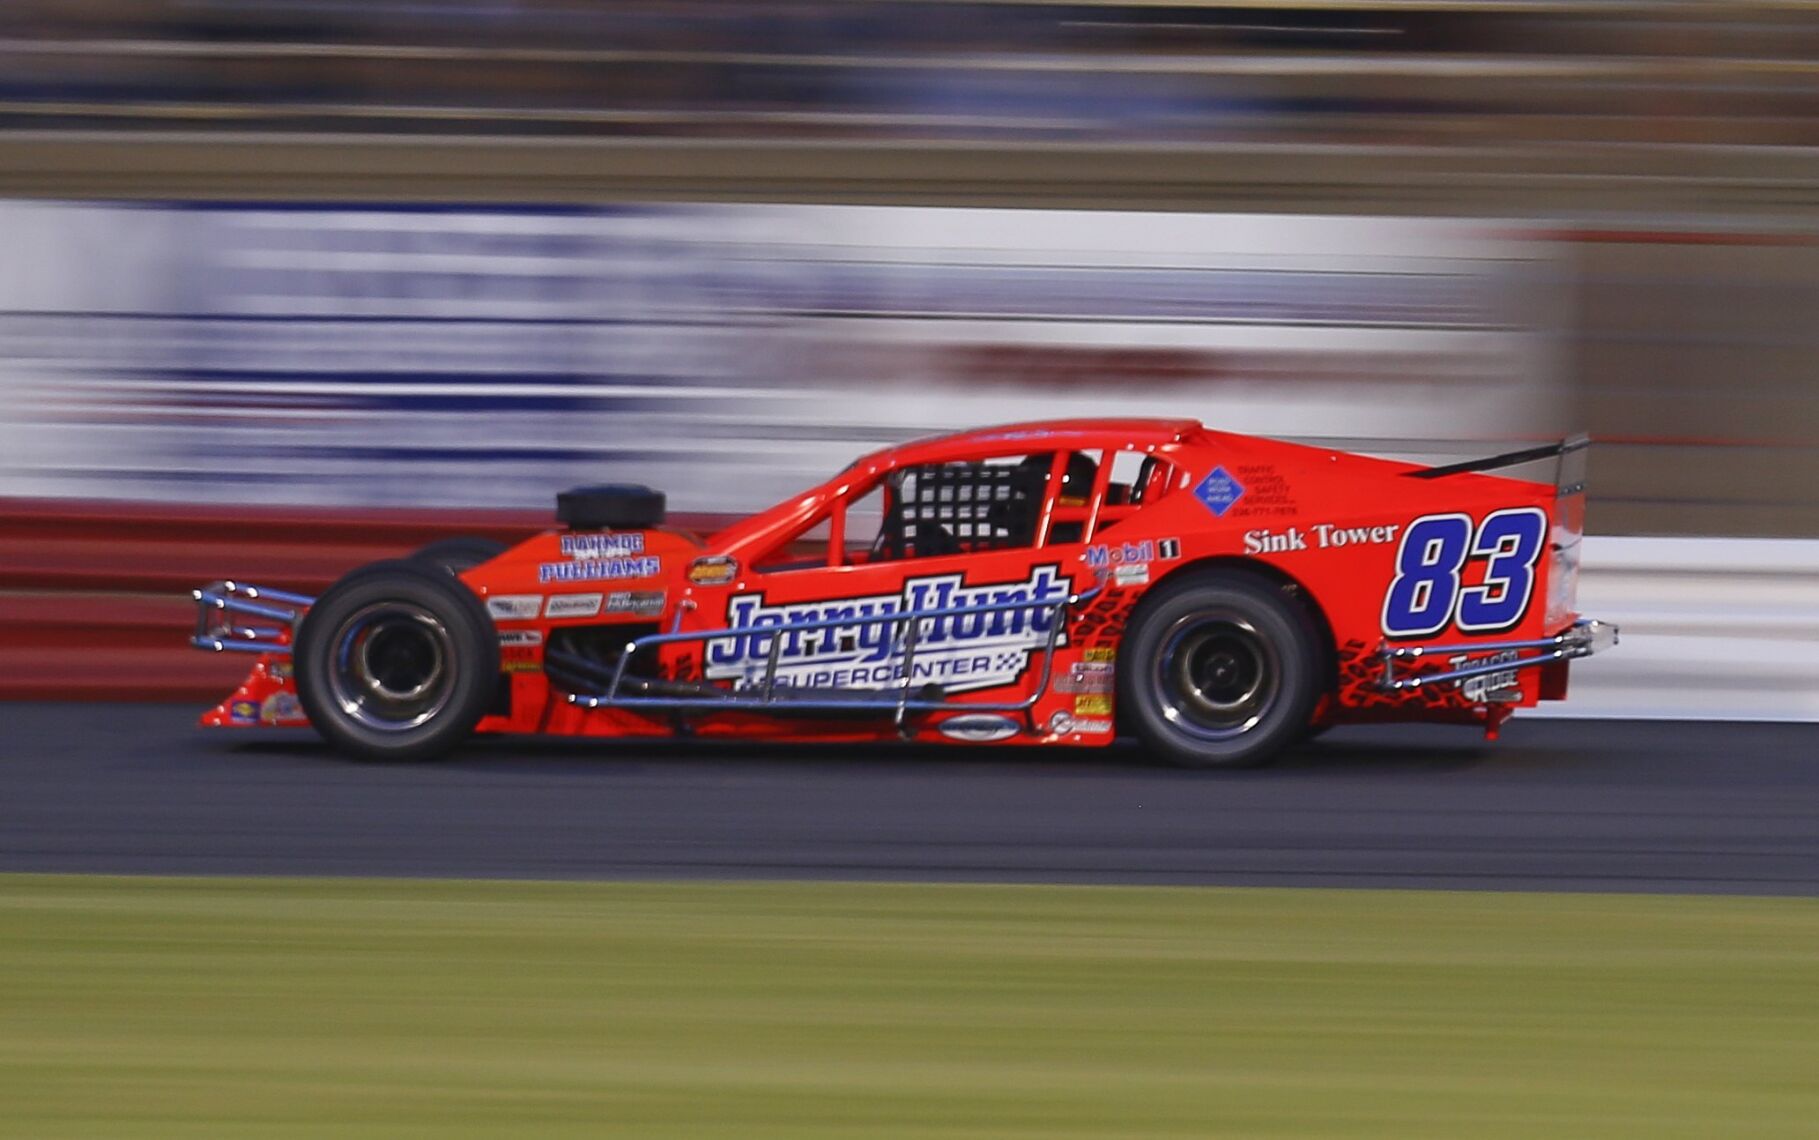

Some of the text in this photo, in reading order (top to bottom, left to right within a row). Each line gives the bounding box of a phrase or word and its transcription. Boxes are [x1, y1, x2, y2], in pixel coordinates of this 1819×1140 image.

[1087, 539, 1155, 567] Mobil
[1243, 523, 1399, 555] Sink Tower
[1381, 506, 1543, 636] 83
[710, 571, 1068, 662] Jerry Hunt
